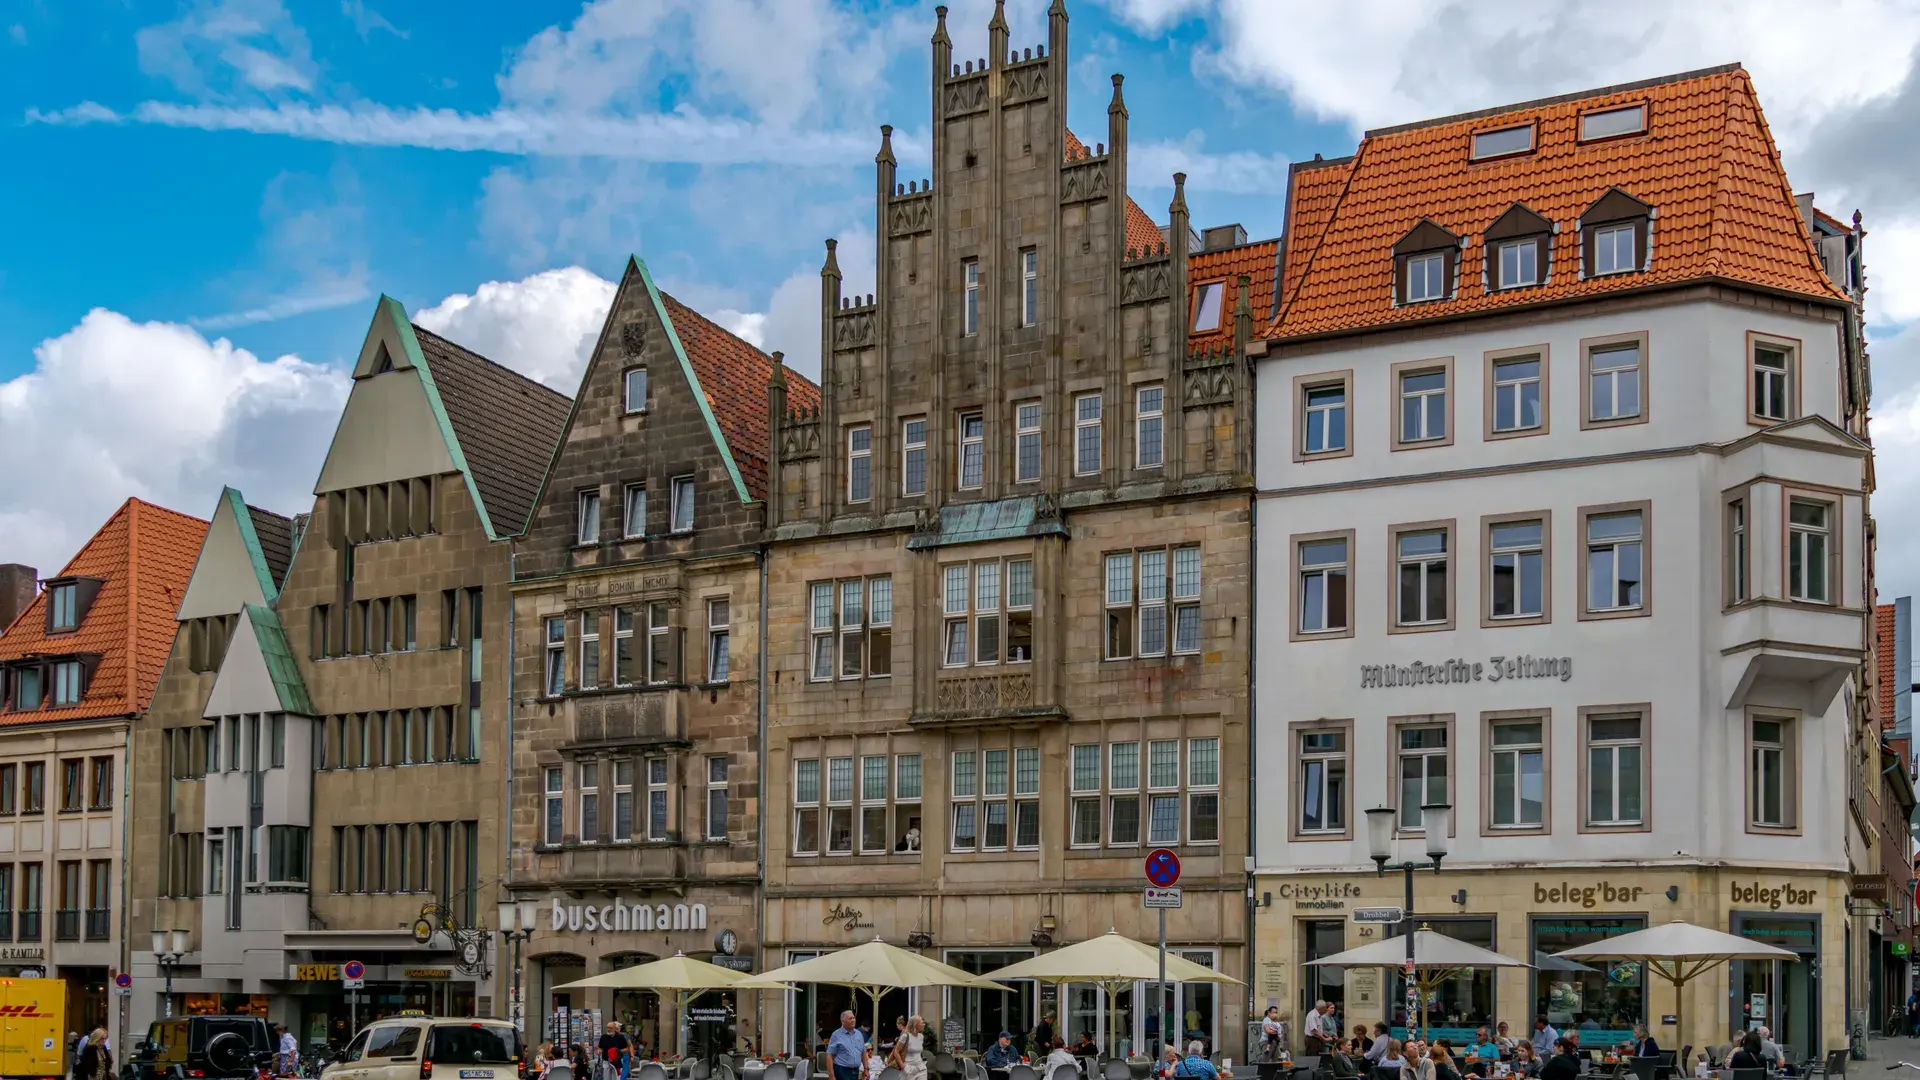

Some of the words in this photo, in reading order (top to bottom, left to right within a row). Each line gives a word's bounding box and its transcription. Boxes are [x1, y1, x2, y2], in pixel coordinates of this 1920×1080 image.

[610, 581, 635, 592] DOMINI
[645, 577, 670, 588] MCMIX
[1487, 654, 1572, 682] Zeitung
[1534, 881, 1643, 908] beleg'bar
[1731, 881, 1817, 909] beleg'bar
[1296, 900, 1345, 909] Immobilien
[552, 897, 707, 931] buschmann
[1359, 927, 1373, 936] 20
[296, 964, 338, 981] REWE
[0, 1005, 41, 1017] HL
